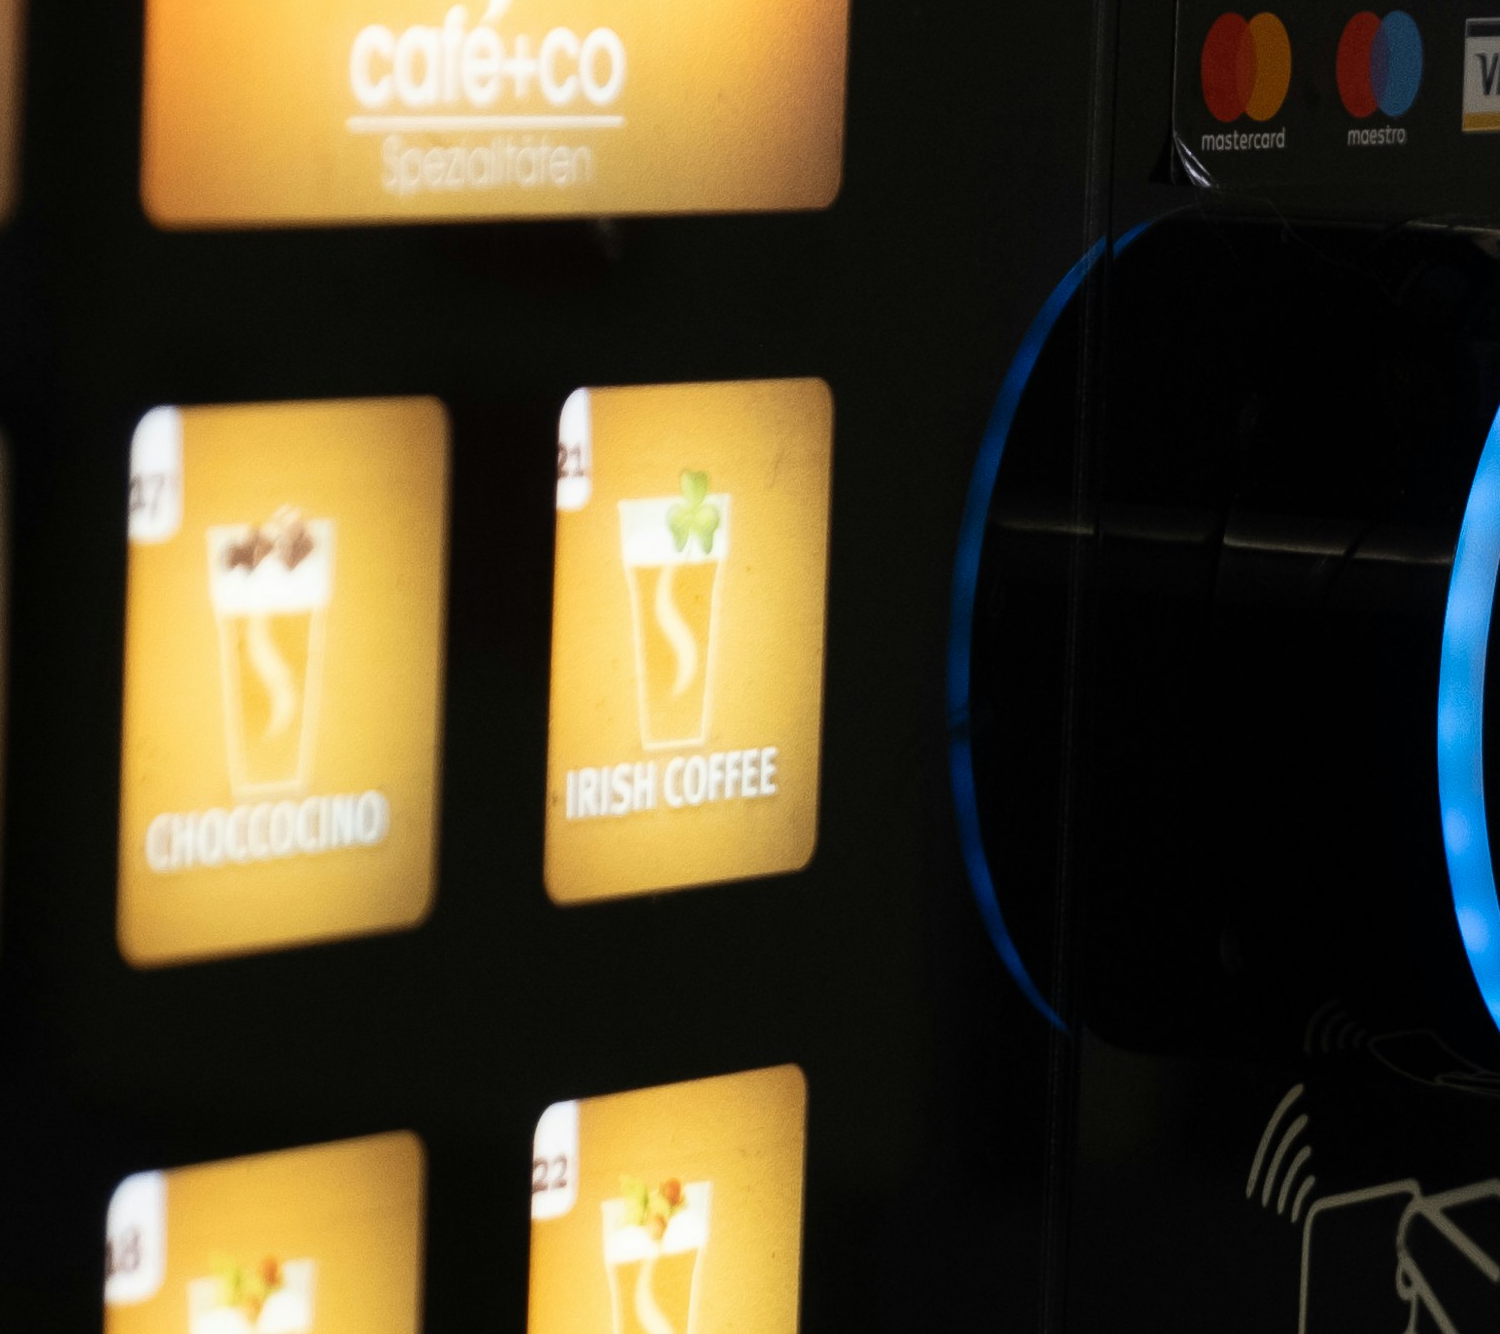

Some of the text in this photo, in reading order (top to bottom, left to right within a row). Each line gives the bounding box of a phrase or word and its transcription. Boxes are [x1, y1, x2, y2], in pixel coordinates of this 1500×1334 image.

[382, 134, 594, 197] Spezialitäten
[1201, 127, 1286, 152] mastercard
[1347, 125, 1407, 147] maestro
[566, 747, 779, 820] IRISH COFFEE
[146, 789, 390, 874] CHOCCOCINO
